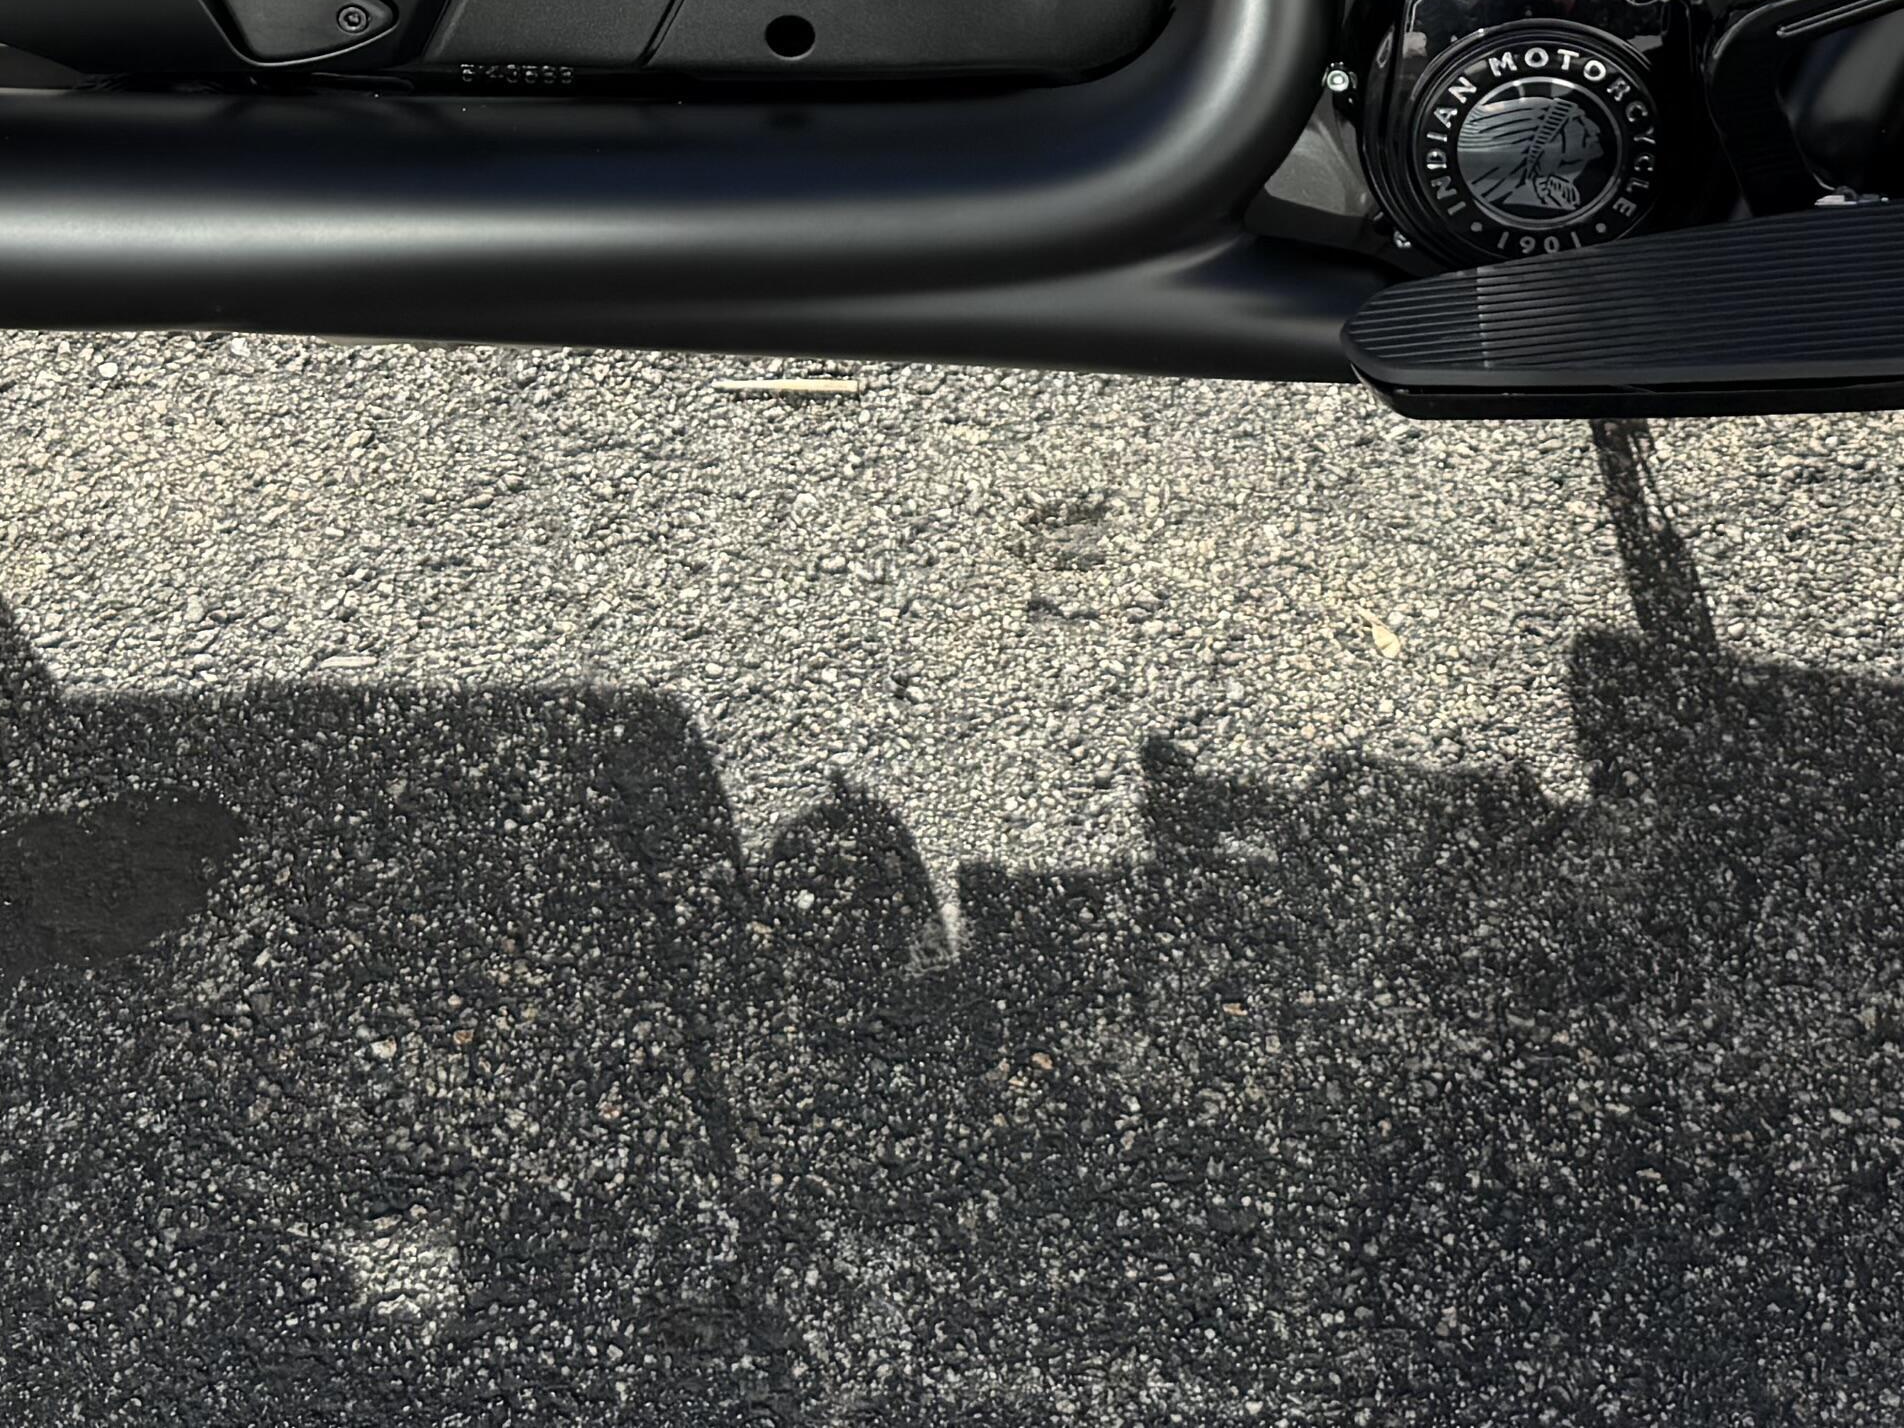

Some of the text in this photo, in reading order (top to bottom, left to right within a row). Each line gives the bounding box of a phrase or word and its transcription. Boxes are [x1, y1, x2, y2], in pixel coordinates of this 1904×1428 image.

[1426, 47, 1657, 217] INDIAN MOTORCYCLE
[1497, 231, 1583, 254] 1901
